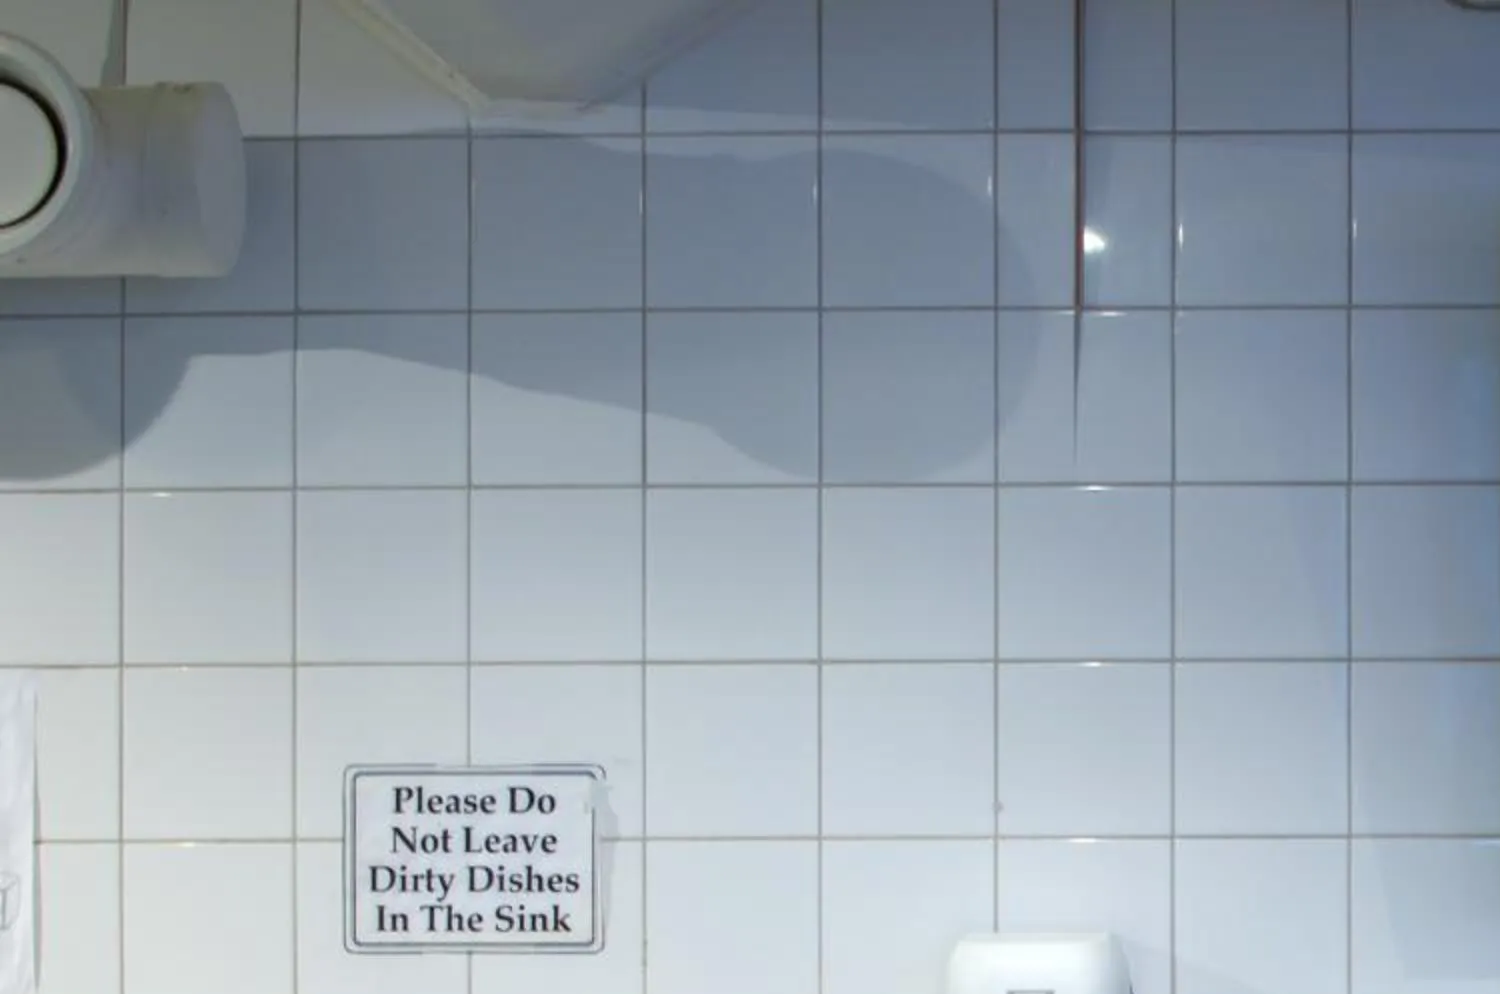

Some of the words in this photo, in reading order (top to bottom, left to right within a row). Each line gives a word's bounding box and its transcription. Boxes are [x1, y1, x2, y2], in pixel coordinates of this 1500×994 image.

[393, 786, 496, 814] Please
[508, 786, 556, 814] Do
[390, 826, 453, 854] Not
[463, 826, 558, 854] Leave
[369, 865, 455, 902] Dirty
[467, 865, 581, 893] Dishes
[376, 905, 409, 932] In
[419, 905, 484, 932] The
[495, 904, 572, 933] Sink
